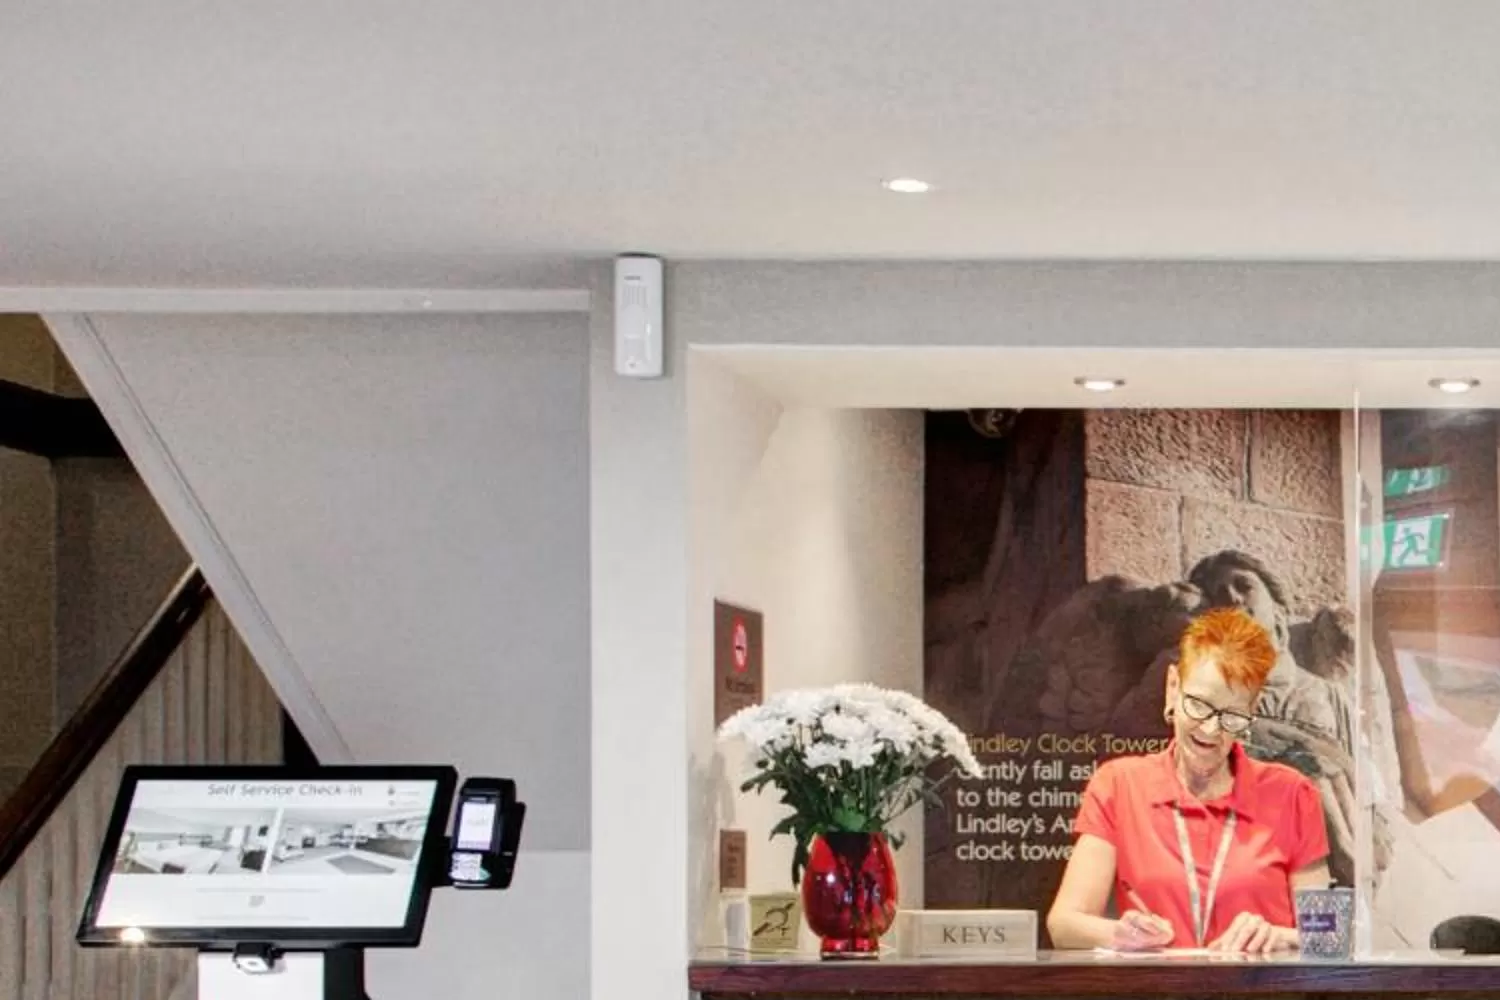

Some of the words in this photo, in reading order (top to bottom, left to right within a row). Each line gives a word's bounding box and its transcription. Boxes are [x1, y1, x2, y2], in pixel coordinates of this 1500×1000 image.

[967, 733, 1031, 756] indley
[1037, 732, 1097, 753] Clock
[1102, 733, 1168, 753] Tower
[1032, 759, 1064, 780] fall
[207, 783, 236, 797] Self
[241, 783, 294, 797] Service
[298, 783, 363, 797] Check-in
[956, 788, 980, 808] to
[986, 786, 1021, 808] the
[956, 813, 1045, 837] Lindley's
[956, 840, 1014, 861] clock
[943, 926, 1005, 944] KEYS
